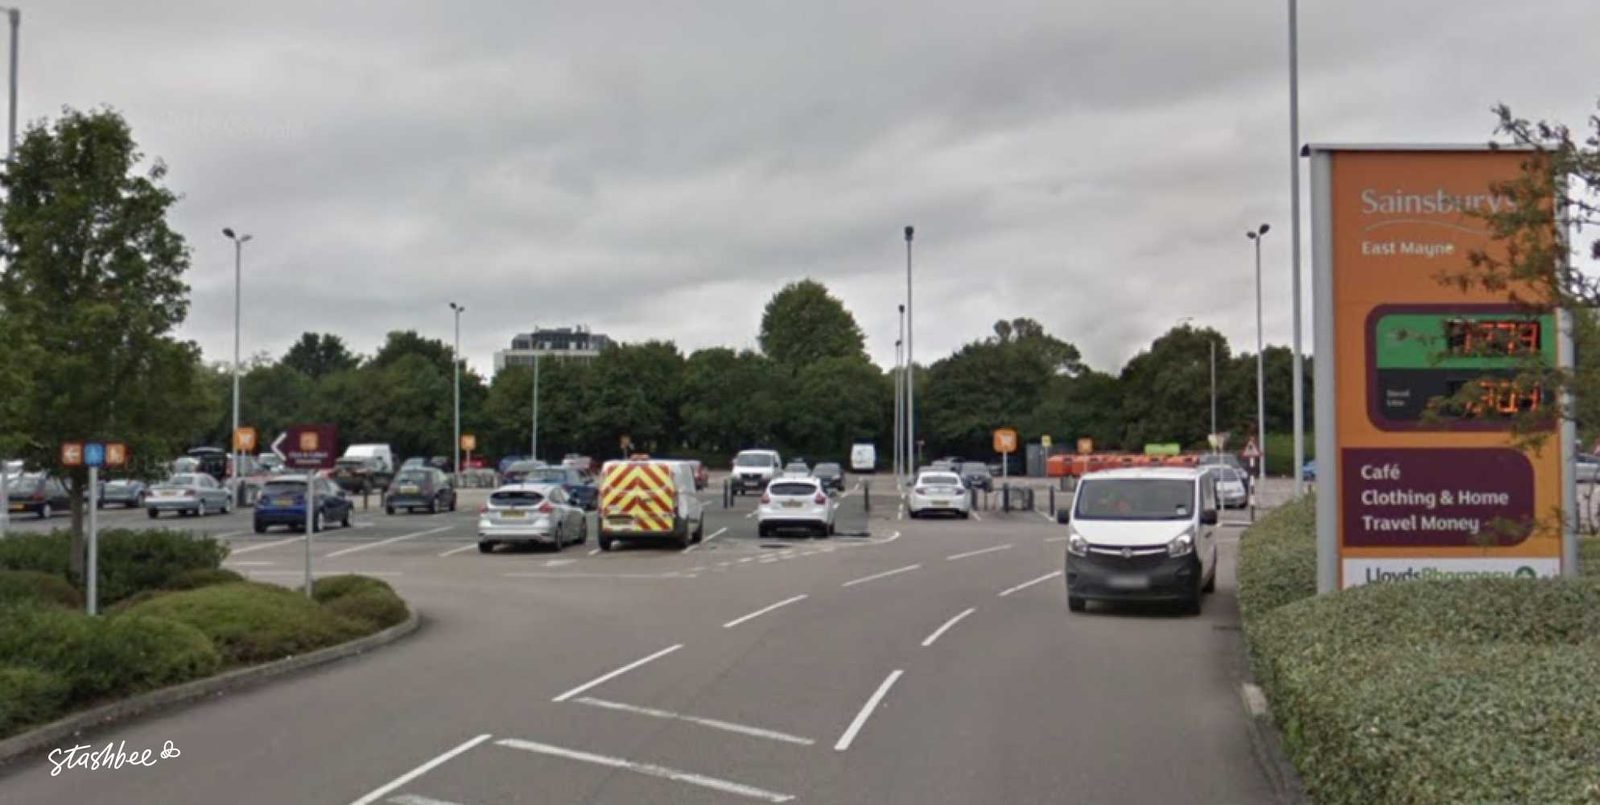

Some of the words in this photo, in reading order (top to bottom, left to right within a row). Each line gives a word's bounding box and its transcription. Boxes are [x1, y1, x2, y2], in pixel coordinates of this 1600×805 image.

[1361, 241, 1395, 255] East
[1400, 241, 1454, 258] Mayne
[1361, 464, 1401, 480] Café
[1361, 489, 1436, 509] Clothing
[1440, 490, 1454, 505] &
[1458, 490, 1509, 505] Home
[1362, 515, 1417, 531] Travel
[1421, 516, 1480, 534] Money
